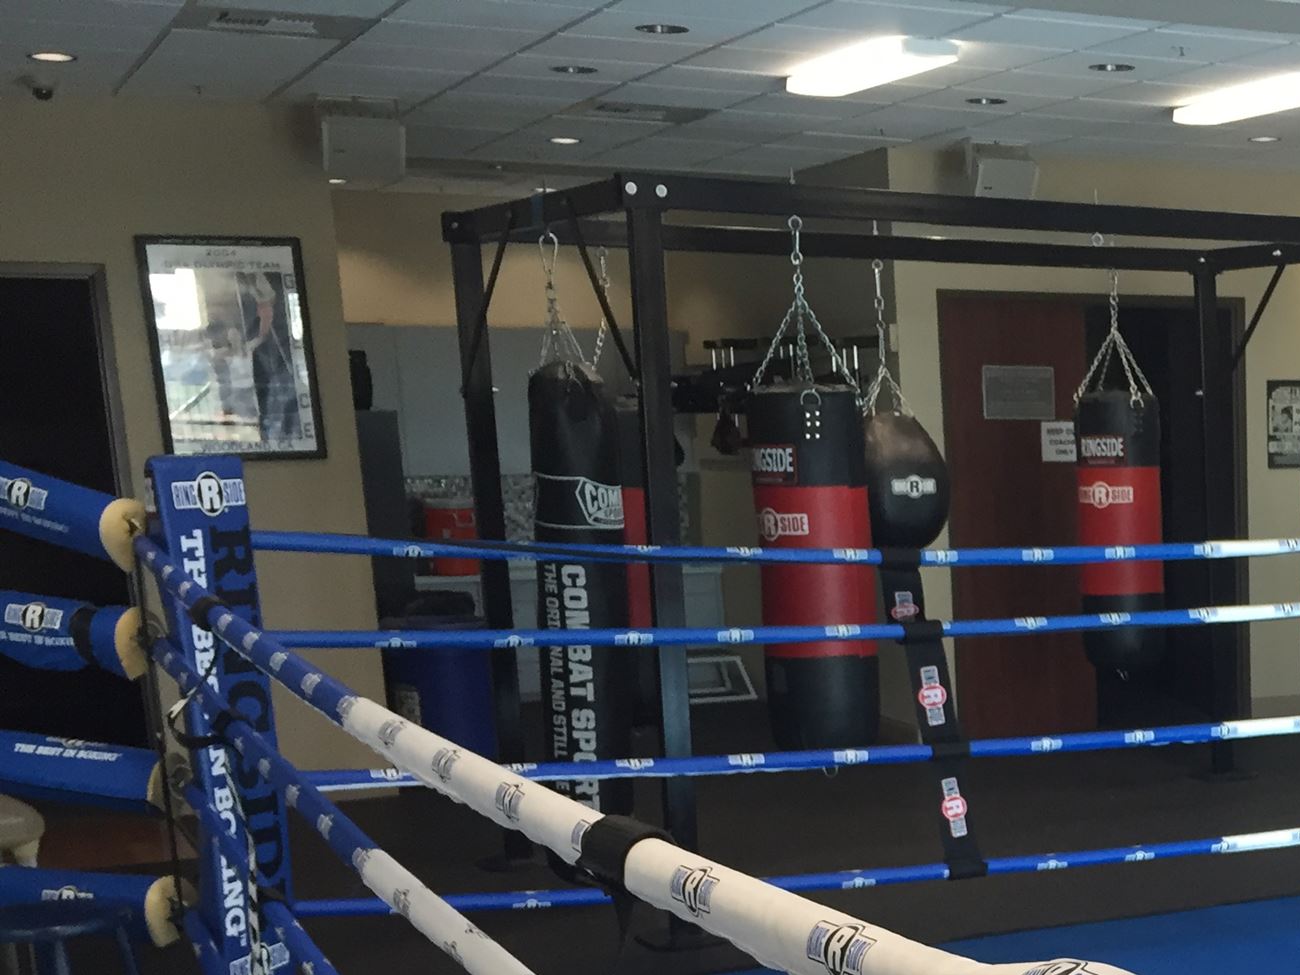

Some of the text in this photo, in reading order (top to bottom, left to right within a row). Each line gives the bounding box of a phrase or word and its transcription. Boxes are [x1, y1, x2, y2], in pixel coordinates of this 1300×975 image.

[780, 516, 807, 533] SIDE
[545, 597, 564, 681] ORINAL
[550, 681, 566, 711] AND
[551, 715, 568, 758] STILL
